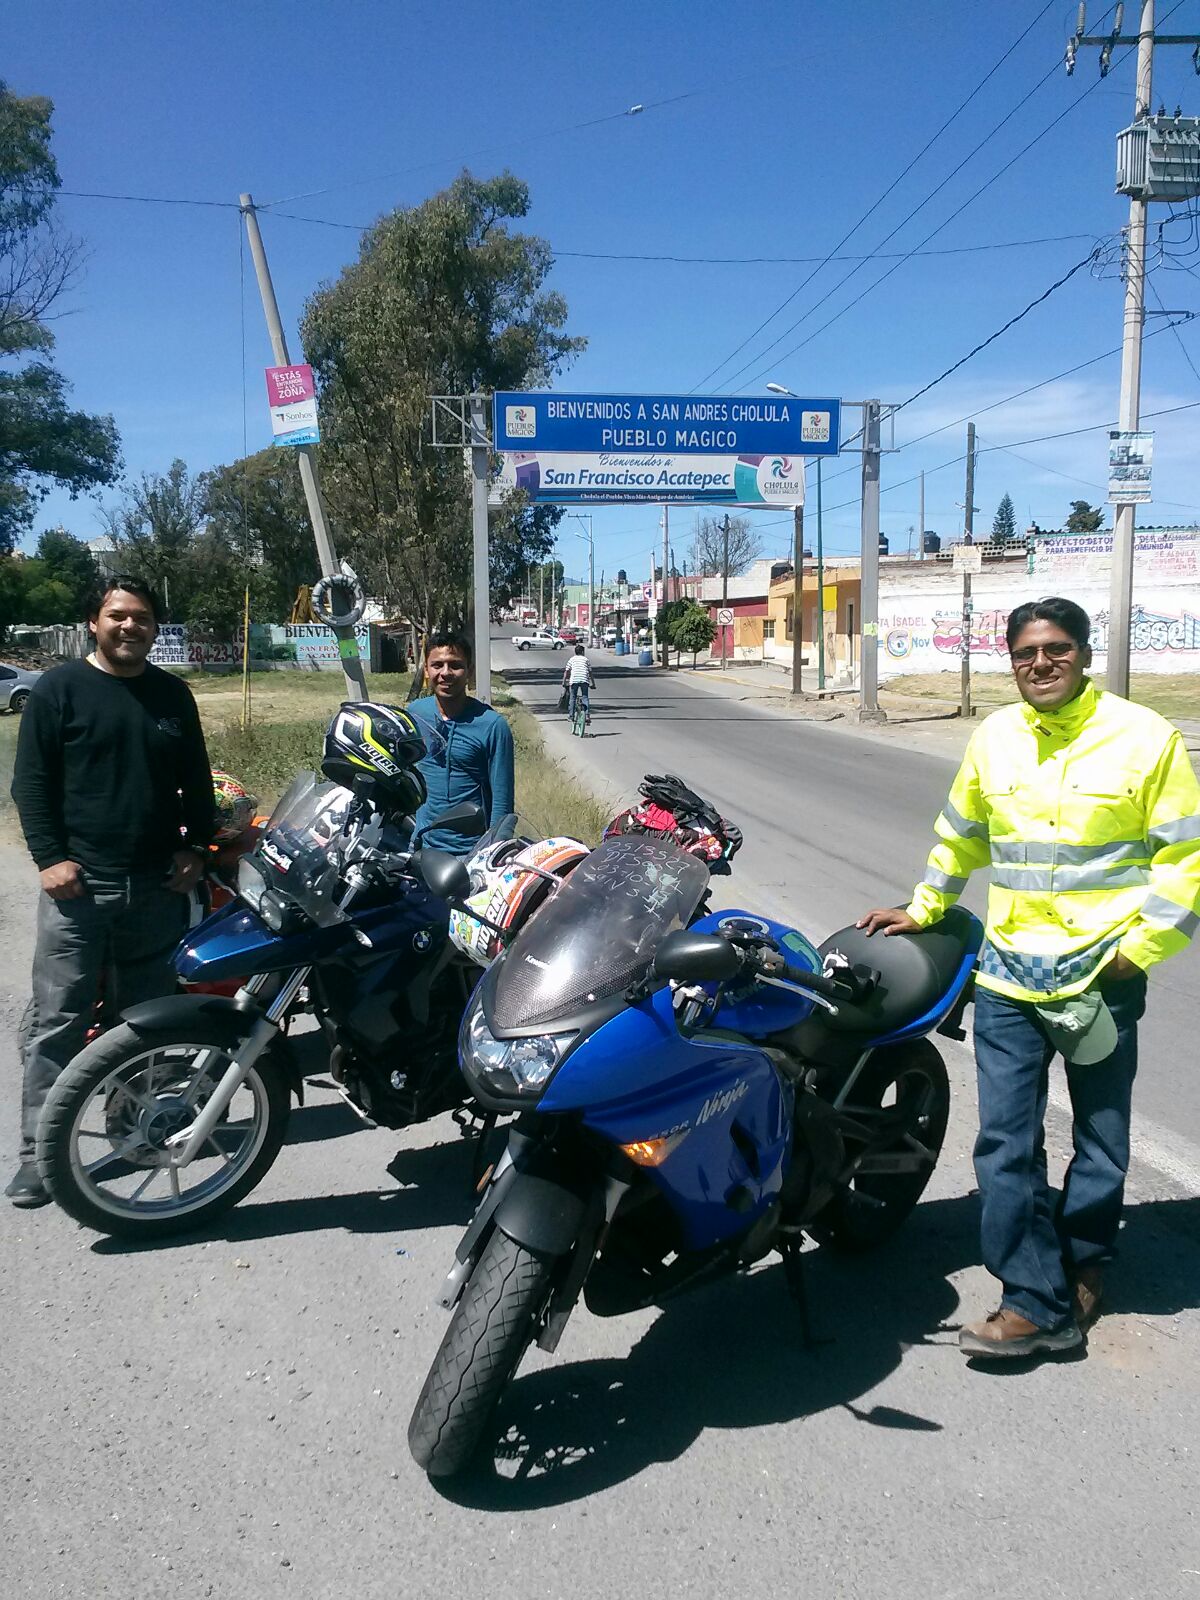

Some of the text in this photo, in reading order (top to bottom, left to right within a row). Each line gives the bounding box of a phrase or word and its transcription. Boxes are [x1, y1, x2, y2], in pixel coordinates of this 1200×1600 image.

[279, 386, 306, 399] ZONA
[548, 401, 790, 422] BIENVENIDOS A SAN ANDRES CHOLULA
[602, 428, 737, 447] PUEBLO MAGICO
[599, 453, 663, 467] Bienvenidos
[544, 469, 731, 489] San Francisco Acatepec
[764, 482, 799, 490] CHOLULA
[1037, 537, 1085, 548] PROYECTO
[1046, 546, 1063, 555] PARA
[1066, 545, 1103, 554] BENEFICIO
[1134, 542, 1174, 551] OMUNIDAD
[156, 647, 184, 655] PIEDRA
[148, 655, 185, 663] TEPETATE
[359, 741, 401, 774] NOLAN
[695, 1077, 749, 1127] Ninja
